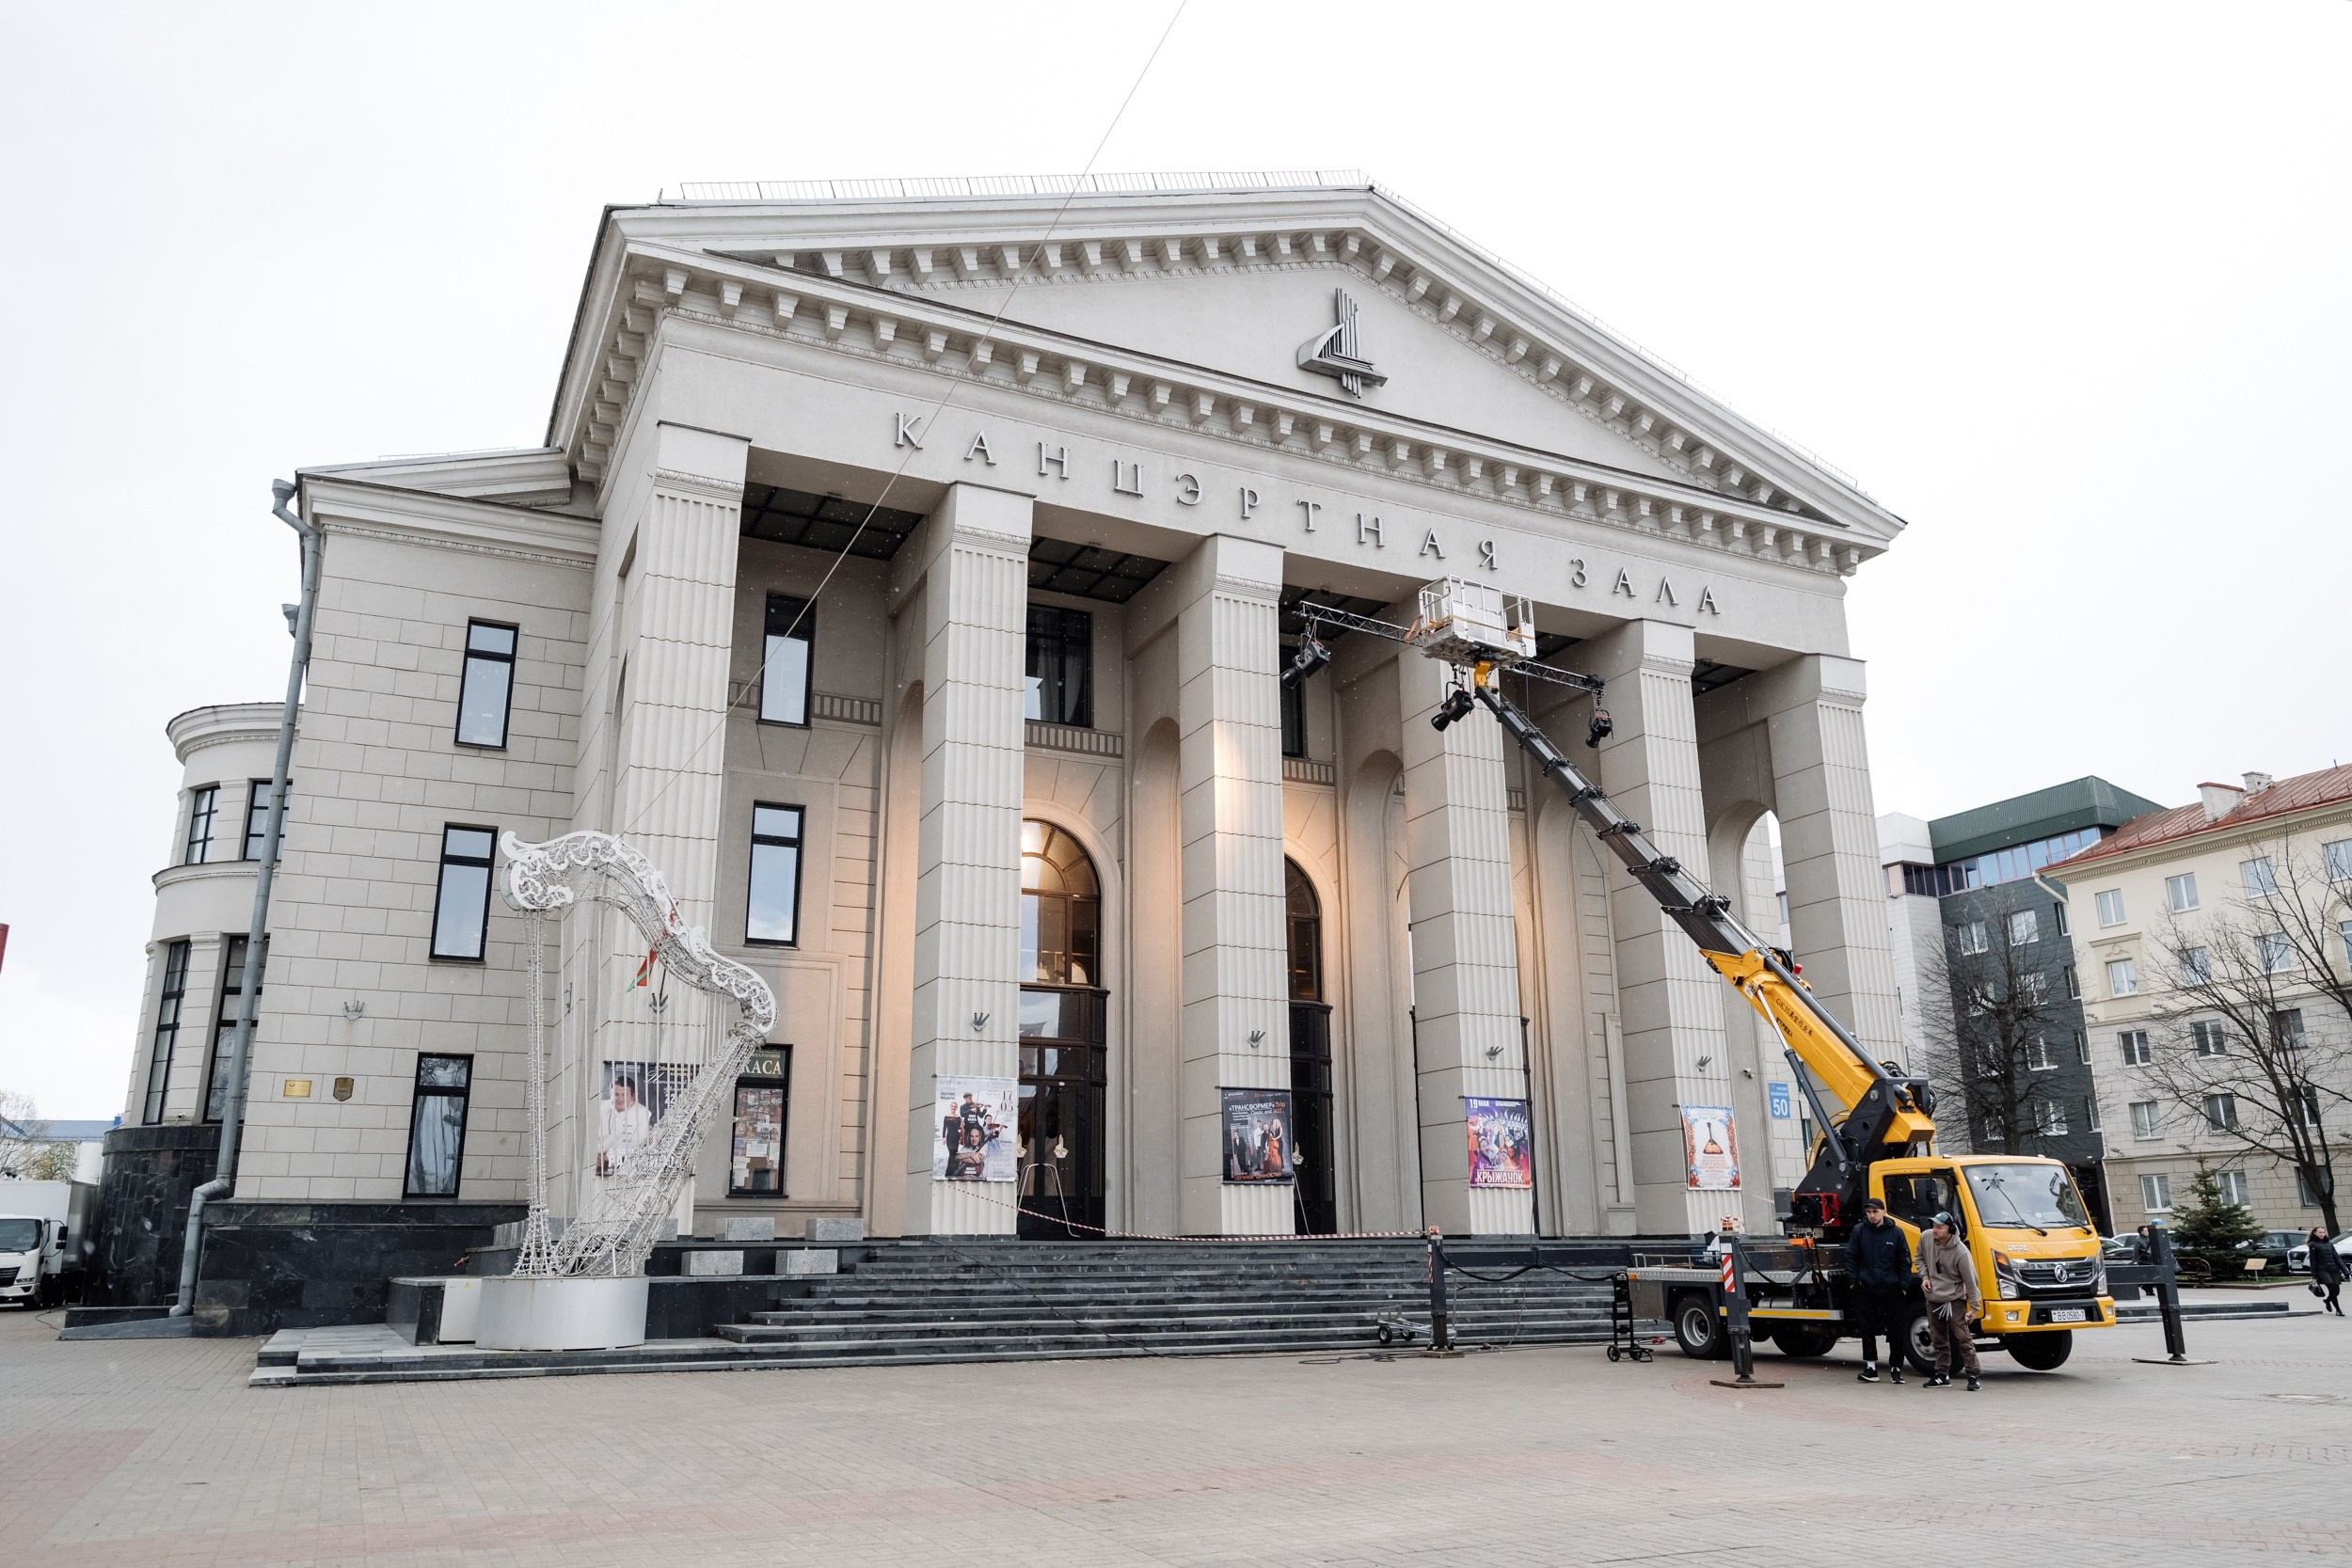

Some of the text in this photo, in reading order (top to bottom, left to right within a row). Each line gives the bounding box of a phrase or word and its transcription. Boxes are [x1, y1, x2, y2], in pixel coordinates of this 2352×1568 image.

[894, 411, 1723, 615] КАНЦЭРТНАЯ ЗАЛА
[1002, 1090, 1013, 1101] 17
[1000, 1102, 1014, 1112] 05
[1469, 1099, 1478, 1109] 19
[1772, 1098, 1788, 1117] 50
